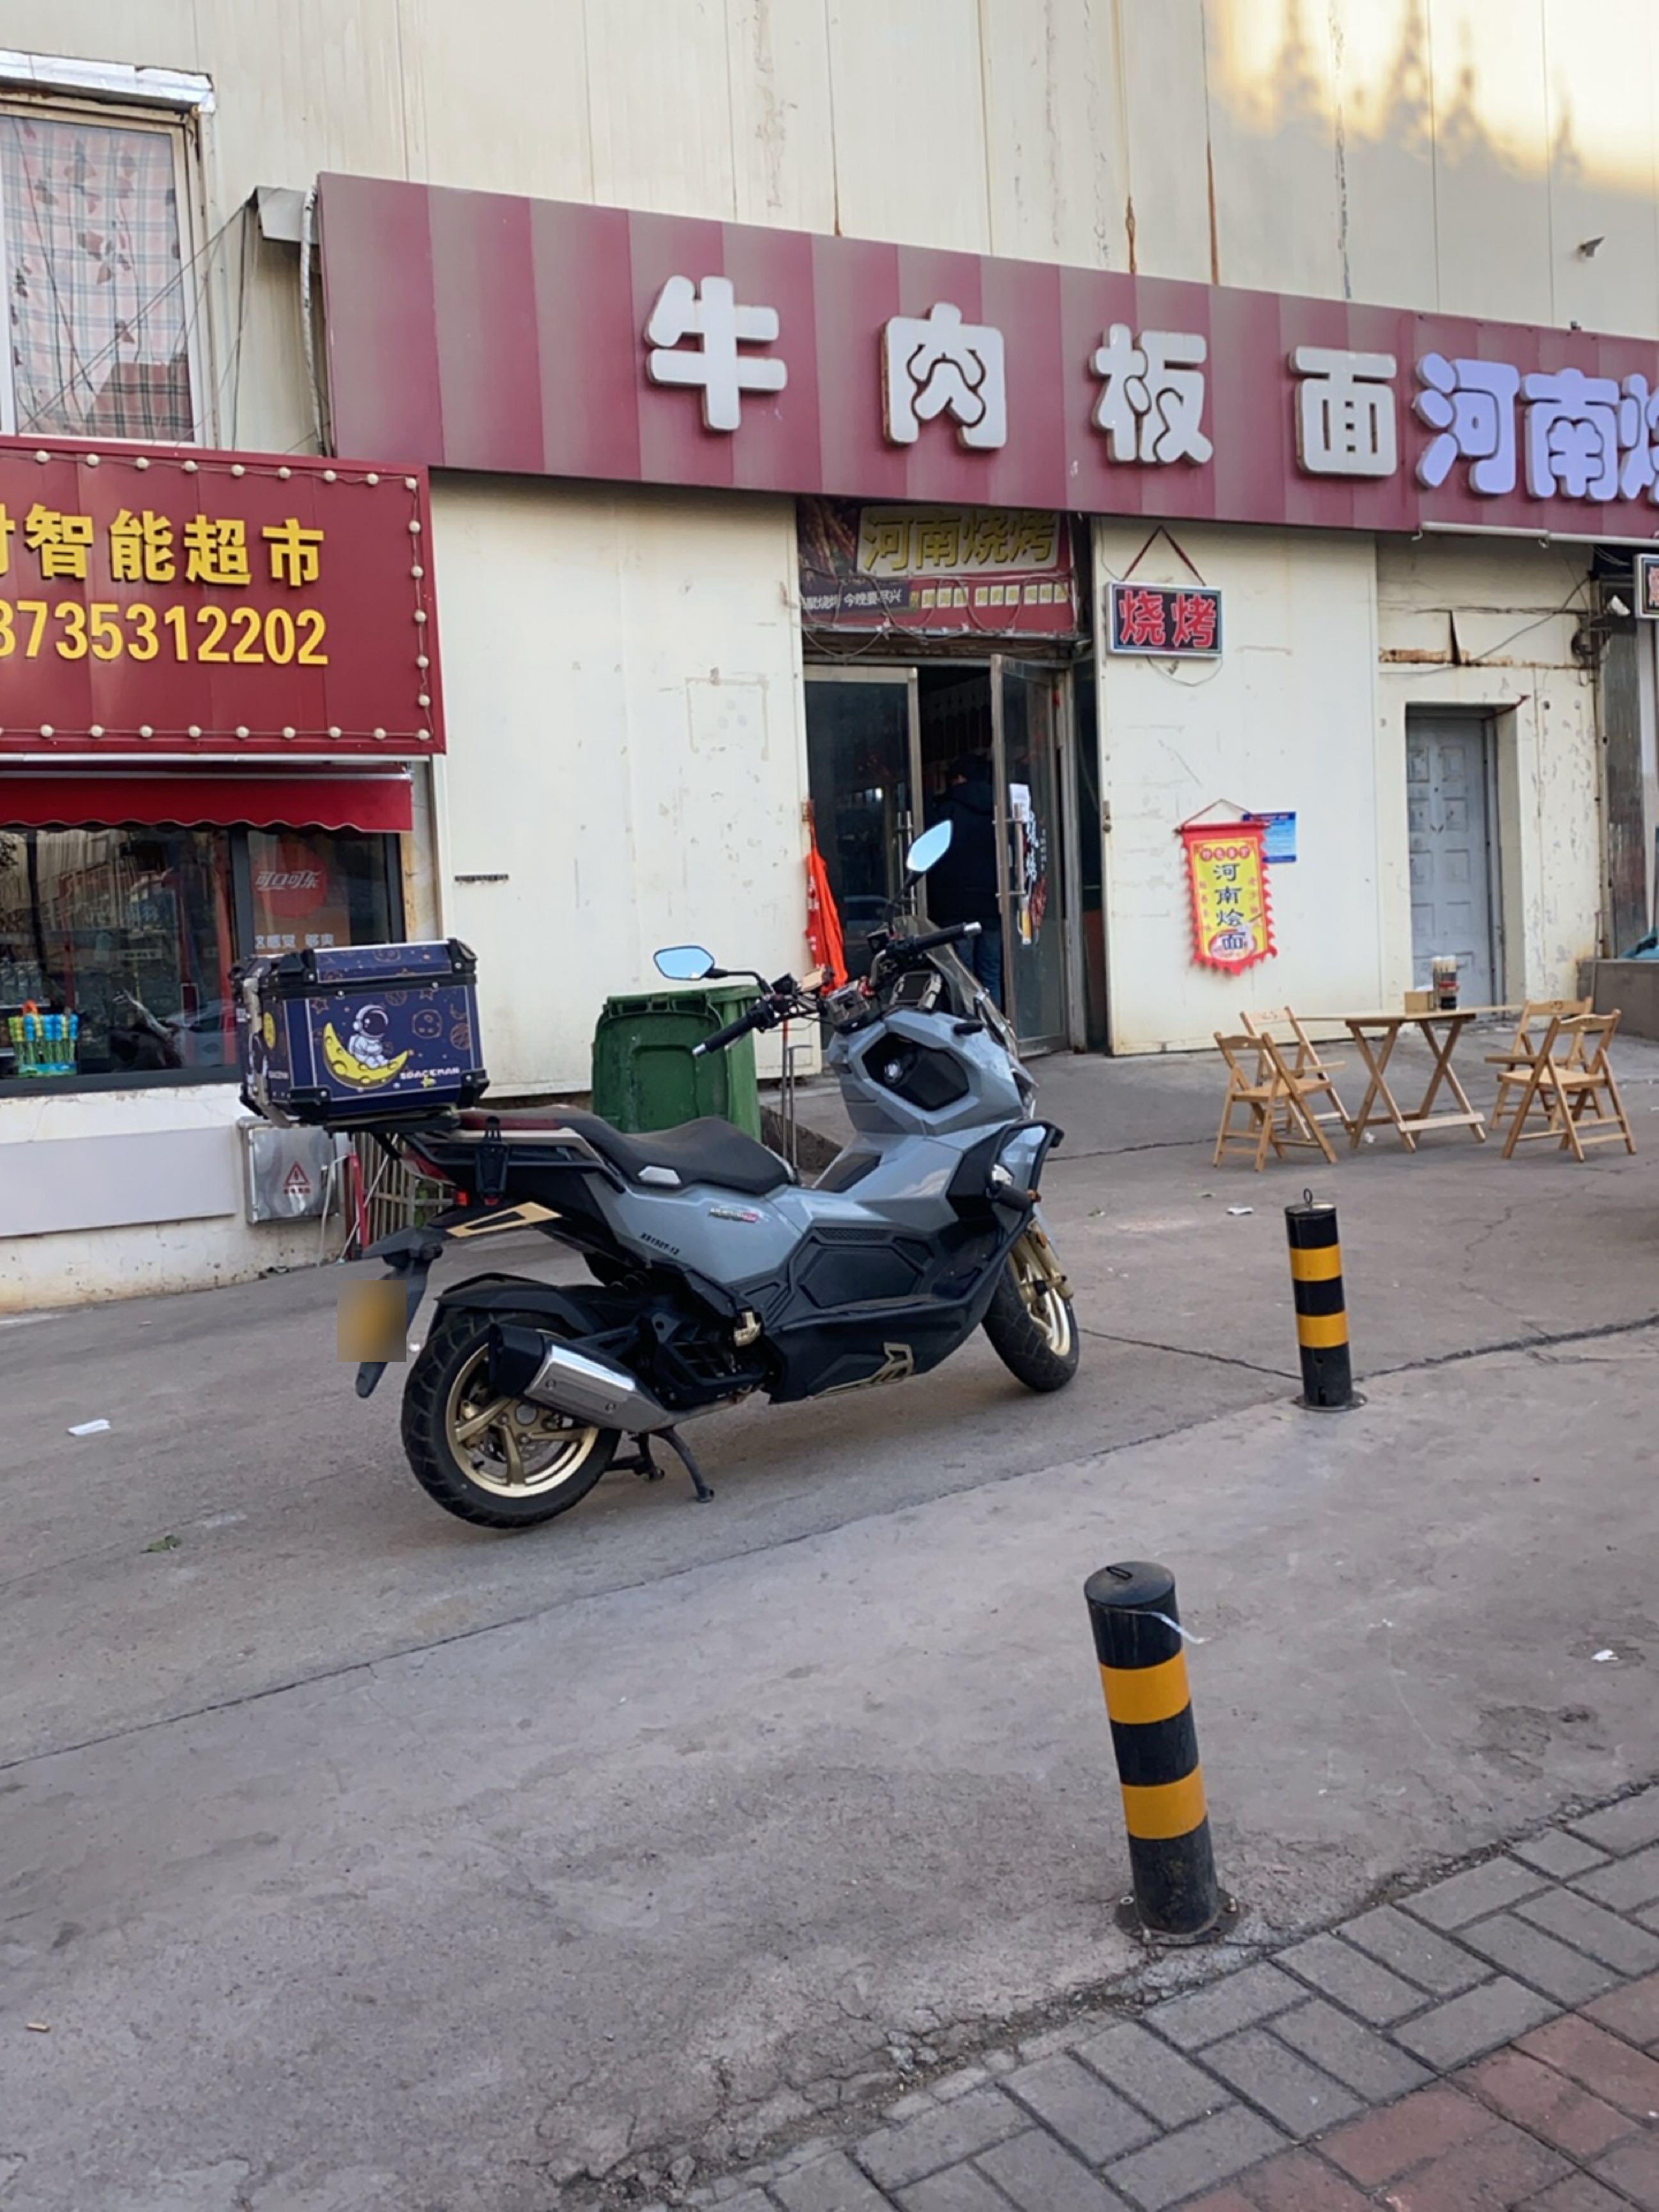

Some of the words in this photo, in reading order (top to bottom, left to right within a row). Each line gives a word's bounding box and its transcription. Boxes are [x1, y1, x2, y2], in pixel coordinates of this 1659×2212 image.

[645, 274, 1397, 477] 牛肉板面
[0, 502, 325, 587] 智能超市
[862, 512, 1057, 571] 河南烧烤
[1119, 589, 1216, 648] 烧烤
[1213, 863, 1247, 950] 河南烩面
